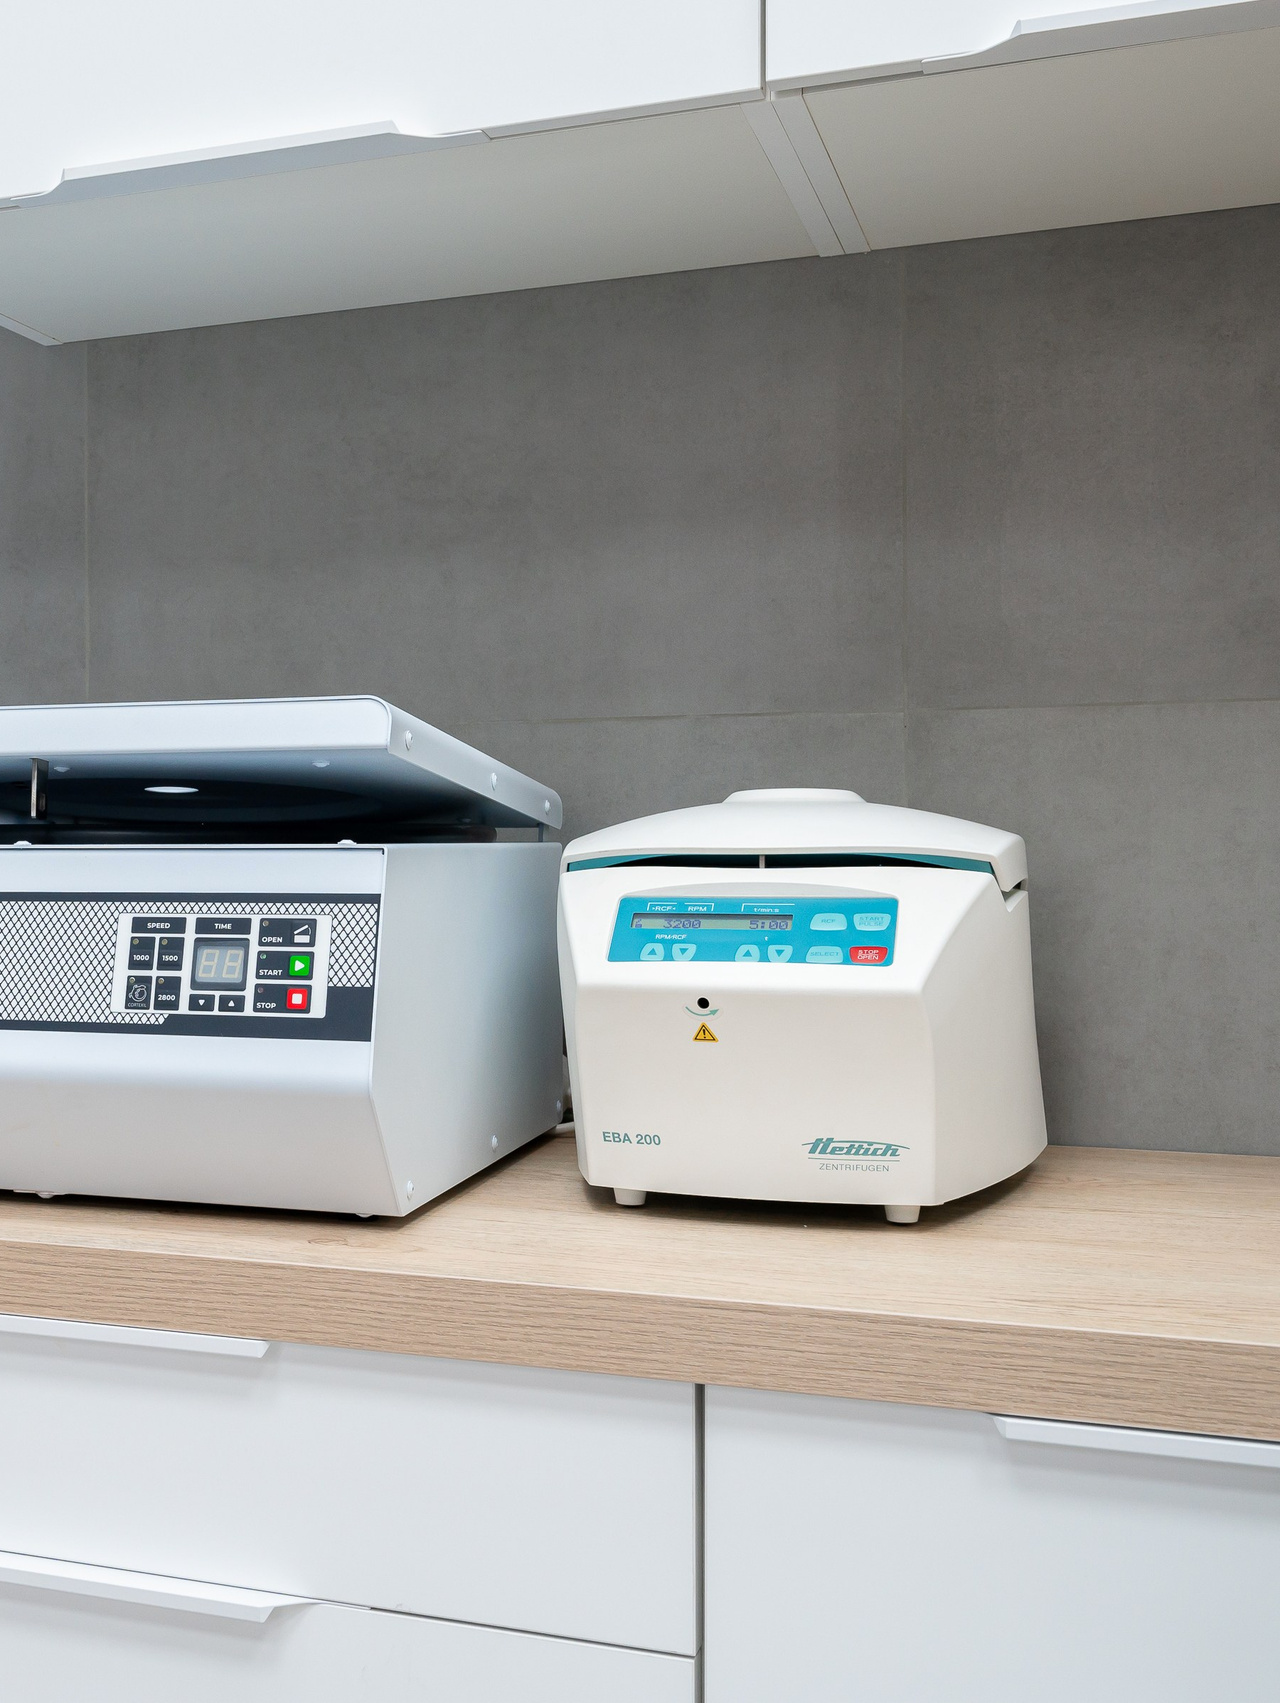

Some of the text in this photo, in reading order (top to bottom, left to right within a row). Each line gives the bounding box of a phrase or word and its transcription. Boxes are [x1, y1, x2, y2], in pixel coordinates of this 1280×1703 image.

[663, 919, 702, 929] 3200
[749, 919, 789, 930] 5:00
[602, 1131, 661, 1146] EBA 200
[807, 1137, 901, 1158] Hettich
[819, 1163, 890, 1172] ZENTRIFUGEN
